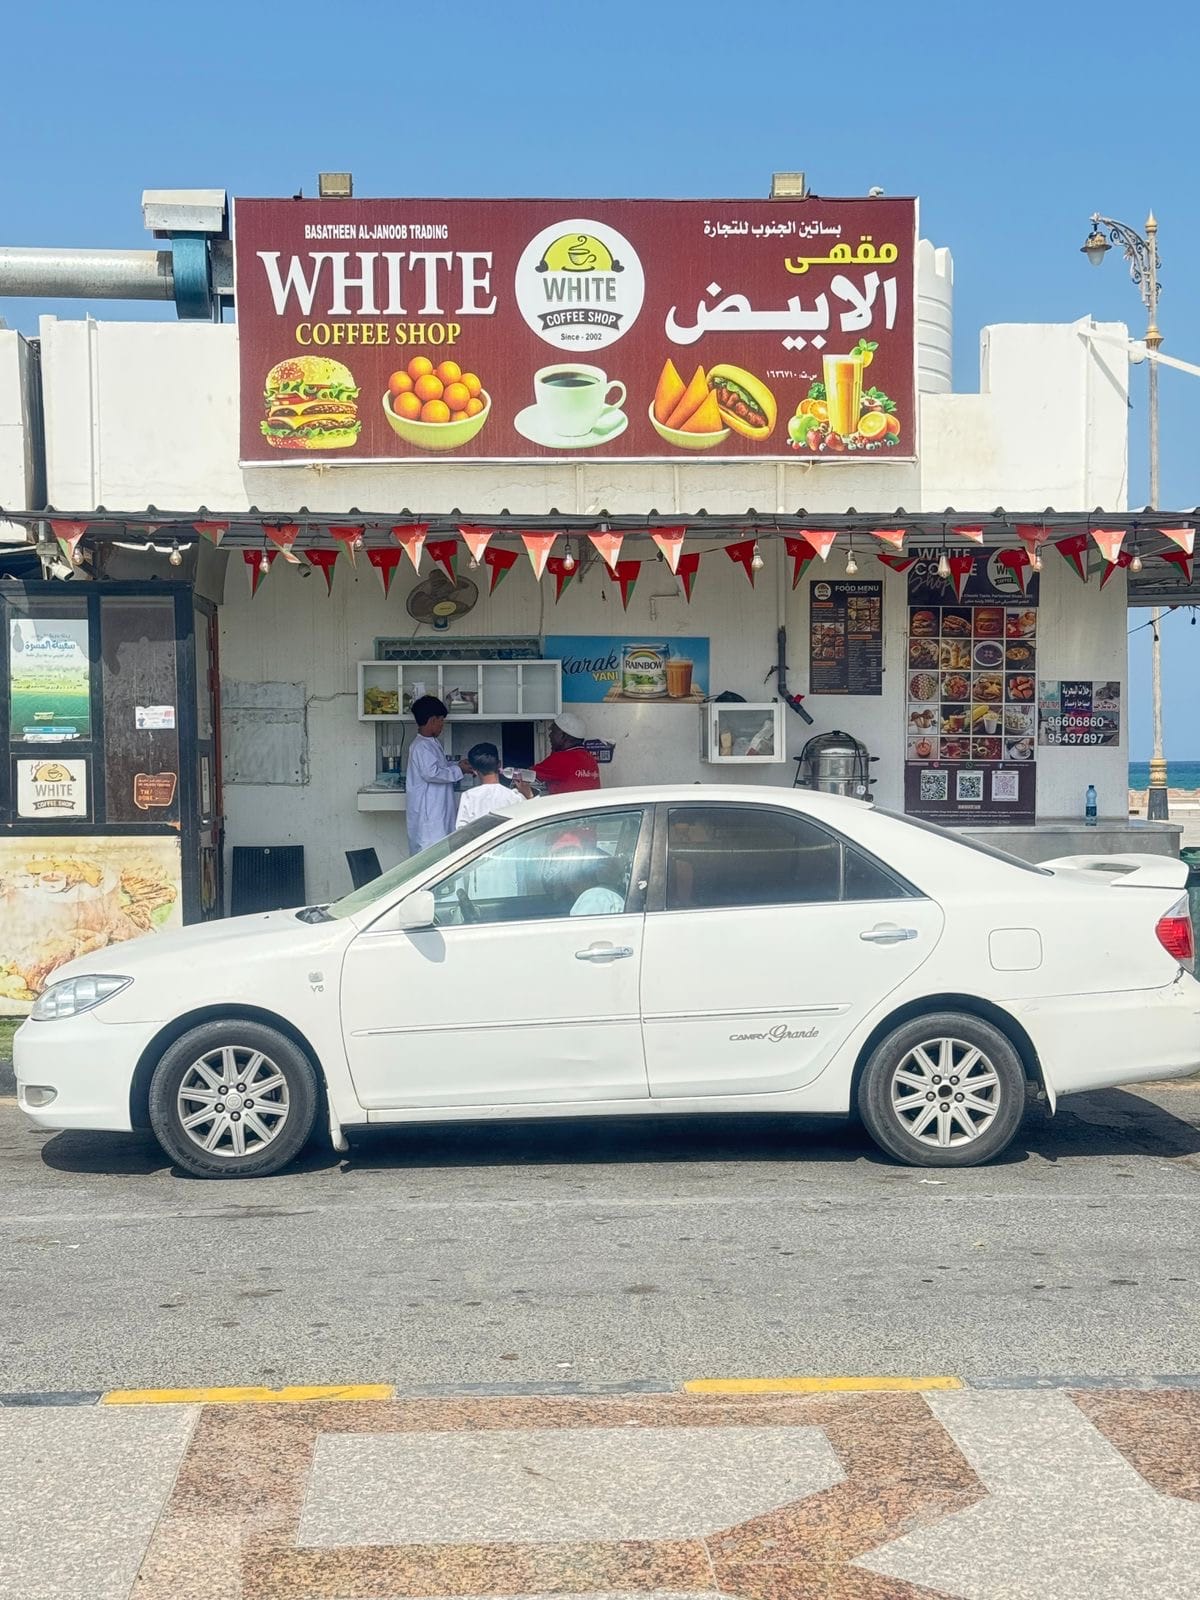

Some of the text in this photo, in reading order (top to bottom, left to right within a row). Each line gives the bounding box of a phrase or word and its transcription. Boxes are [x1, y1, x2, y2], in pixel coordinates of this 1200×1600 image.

[304, 224, 449, 239] BASATHEEN AL-JANOOB TRADING
[703, 220, 842, 238] بساتين الجنوب للتجارة
[784, 235, 898, 274] مقهى
[256, 251, 498, 316] WHITE
[543, 277, 616, 302] WHITE
[665, 271, 898, 350] الابيض
[546, 311, 616, 326] COFFEE SHOP
[295, 322, 461, 345] COFFEE SHOP
[561, 333, 580, 341] Since
[586, 333, 602, 341] 2002
[915, 562, 978, 576] COE
[625, 660, 663, 670] RAINBOW
[592, 671, 618, 681] YANI
[1048, 716, 1104, 727] 96606860
[1048, 733, 1104, 743] 95437897
[35, 784, 72, 796] WHITE
[729, 1024, 819, 1043] CAMRY Grande
